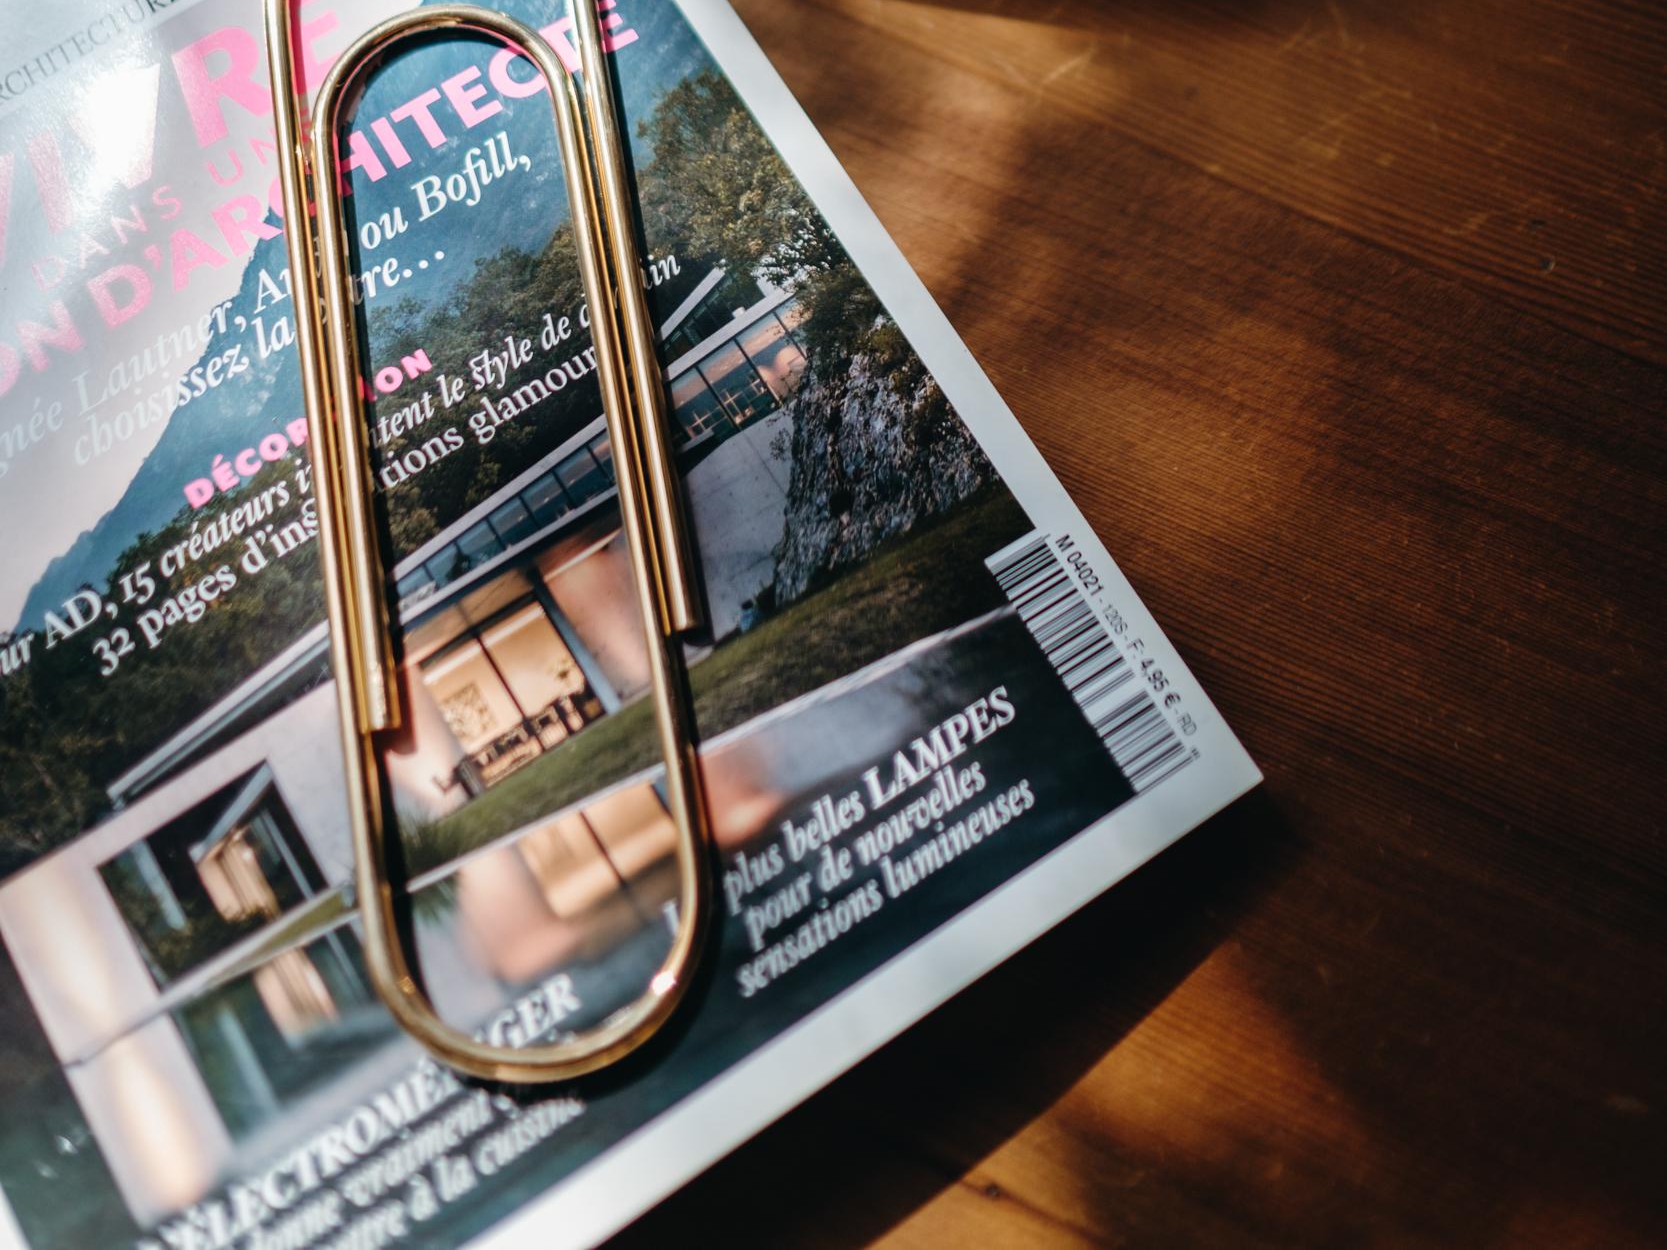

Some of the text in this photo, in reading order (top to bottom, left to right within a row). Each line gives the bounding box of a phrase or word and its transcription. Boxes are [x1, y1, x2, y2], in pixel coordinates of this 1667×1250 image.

[31, 184, 183, 292] DANS
[71, 299, 248, 410] Lautner,
[361, 206, 409, 250] ou
[411, 131, 532, 223] Bofill,
[44, 589, 119, 650] AD,
[118, 560, 156, 605] 15
[159, 479, 290, 579] créateurs
[437, 374, 466, 410] le
[468, 335, 534, 392] style
[540, 313, 573, 351] de
[73, 344, 249, 467] choisissez
[250, 316, 296, 360] la
[92, 627, 136, 677] 32
[137, 563, 237, 650] pages
[467, 345, 598, 446] glamour
[1055, 533, 1075, 552] M
[1066, 550, 1105, 597] 04021
[1139, 656, 1170, 693] 4,95
[1163, 691, 1182, 709] €
[722, 843, 786, 917] plus
[780, 791, 866, 863] belles
[861, 685, 1017, 812] LAMPES
[735, 778, 1037, 999] sensations lumineuses
[743, 867, 814, 951] pour
[816, 843, 855, 894] de
[854, 760, 987, 866] nouvelles
